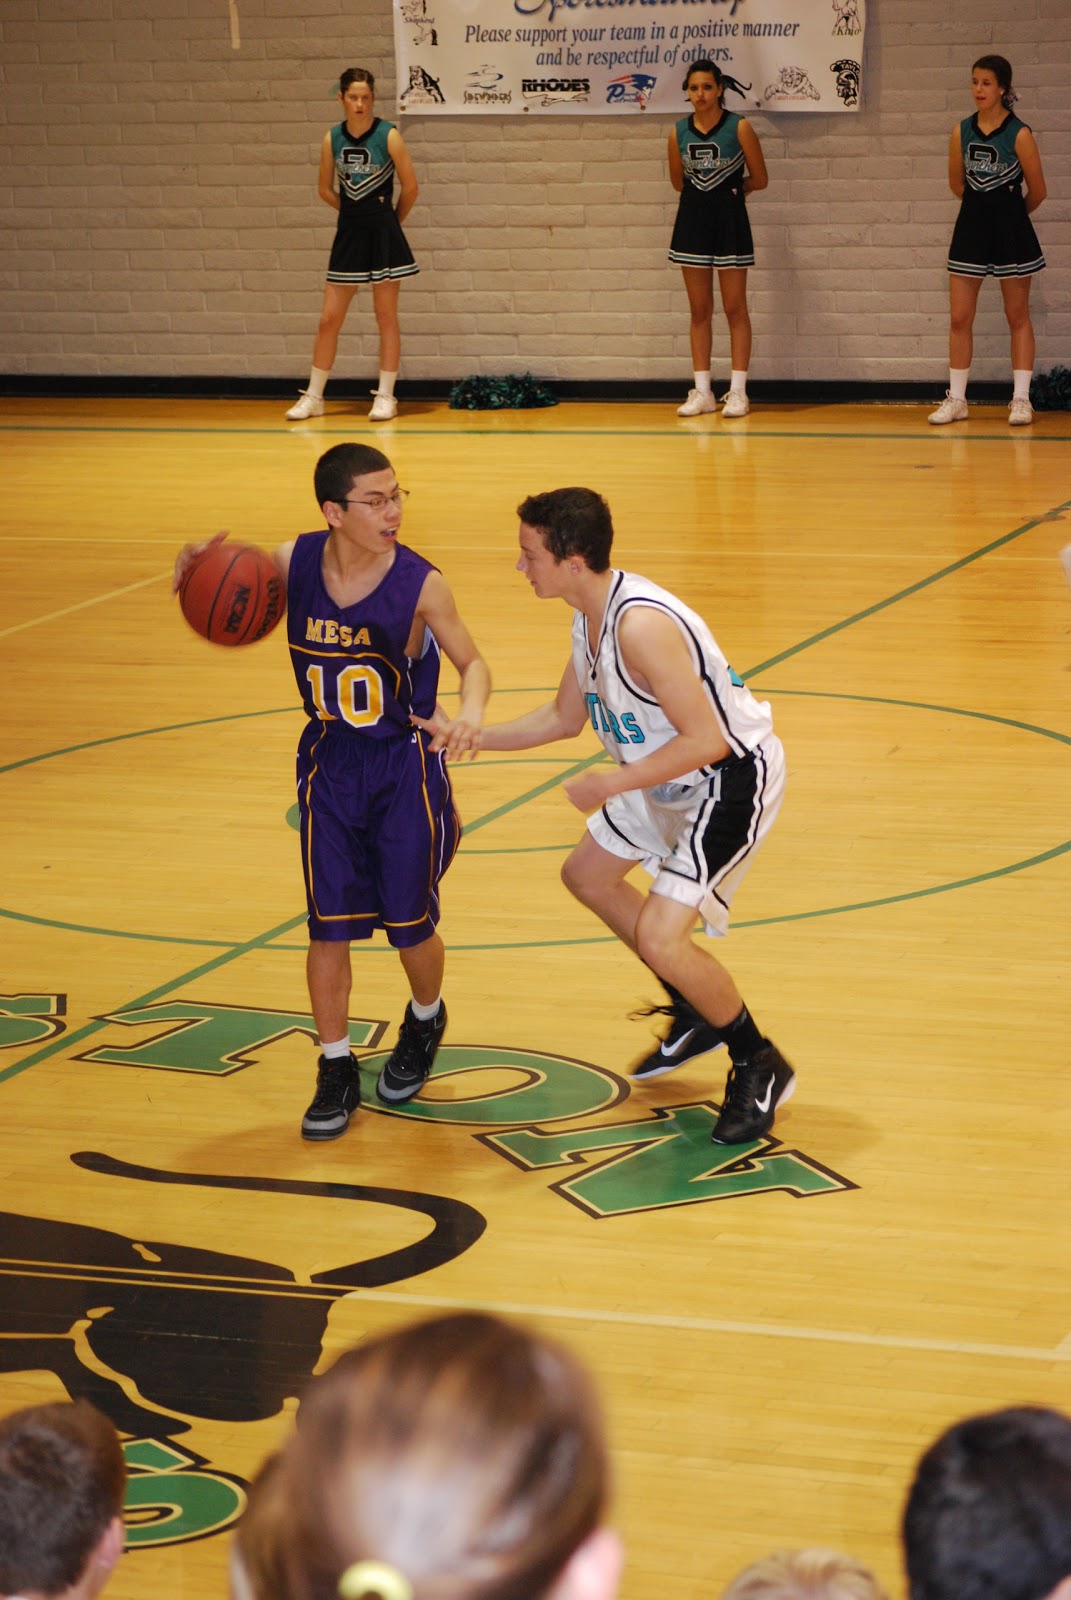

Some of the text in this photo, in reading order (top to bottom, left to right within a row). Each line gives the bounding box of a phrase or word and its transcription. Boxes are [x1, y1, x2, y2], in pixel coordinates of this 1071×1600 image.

[465, 19, 800, 47] Please support your team in a positive manner
[536, 44, 733, 69] and be respectful of others.
[522, 78, 591, 92] RHODES
[305, 616, 371, 648] MESA
[306, 664, 384, 729] 10
